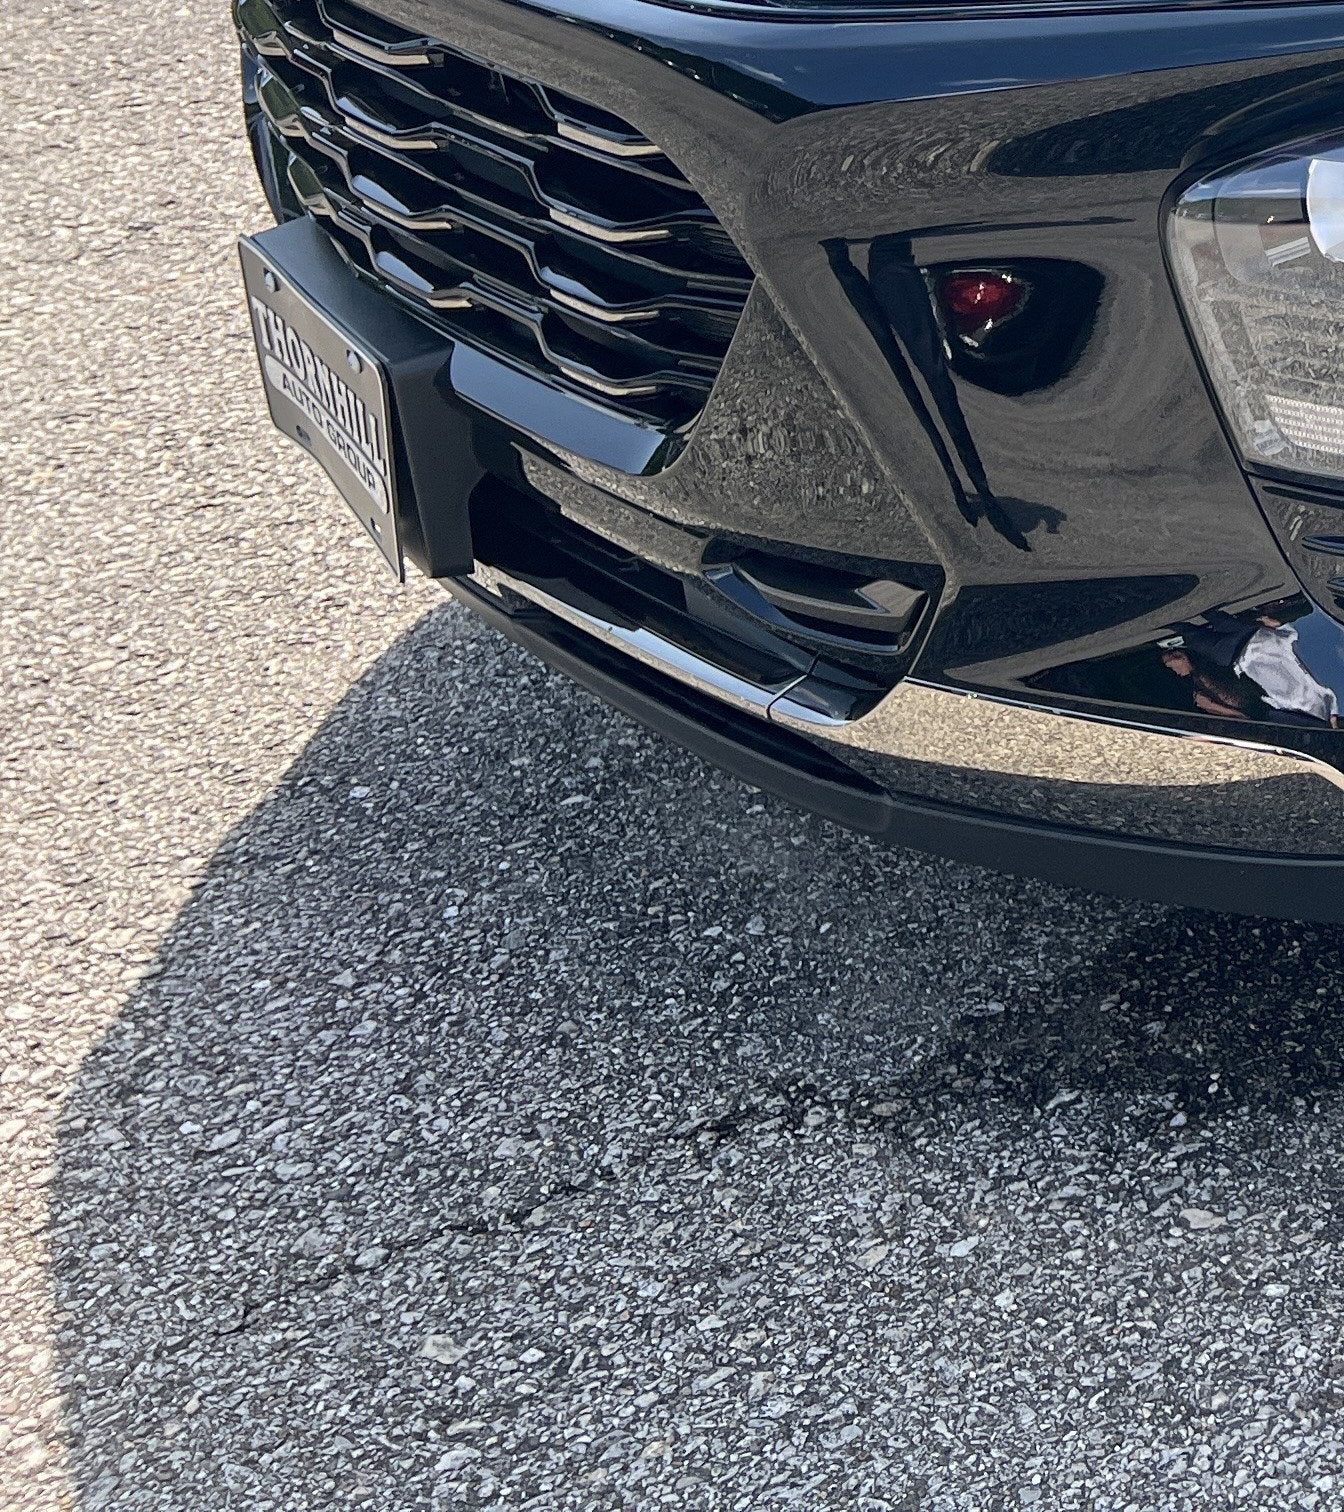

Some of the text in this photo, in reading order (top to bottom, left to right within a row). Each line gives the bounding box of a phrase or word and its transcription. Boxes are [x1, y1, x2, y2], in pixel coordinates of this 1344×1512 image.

[251, 297, 386, 476] THORNHILL
[282, 373, 376, 489] AUTO GROUP
